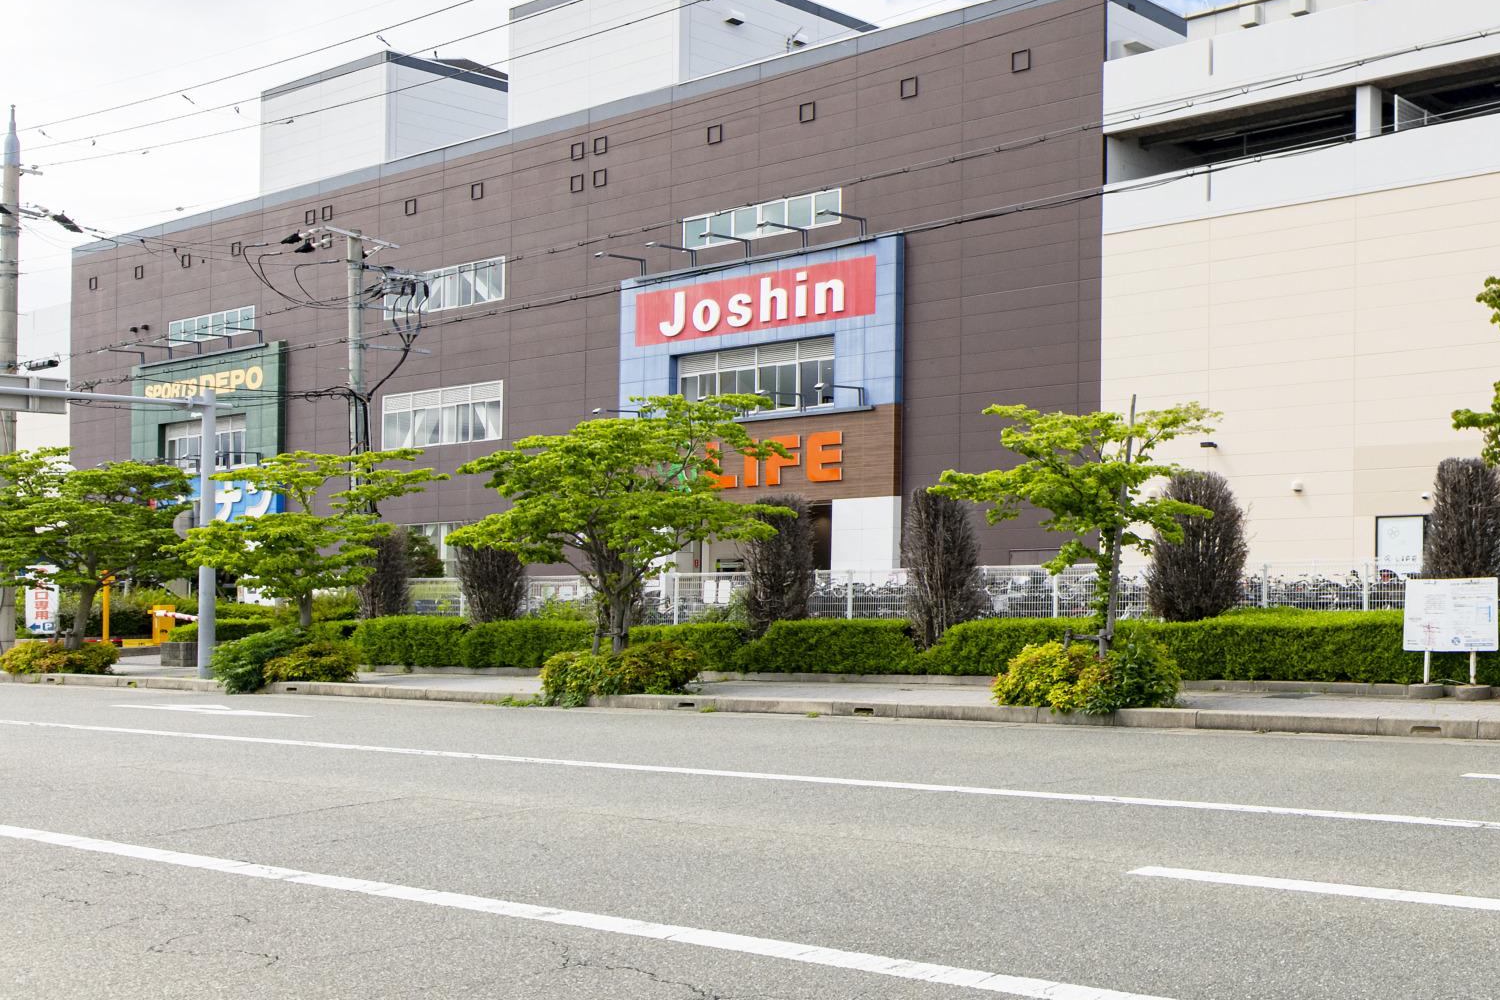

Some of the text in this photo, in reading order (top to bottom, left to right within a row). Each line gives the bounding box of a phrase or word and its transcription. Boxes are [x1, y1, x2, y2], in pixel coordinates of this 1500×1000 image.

[659, 271, 845, 338] Joshin
[144, 366, 264, 400] SPORTS DEPO
[705, 431, 843, 489] LIFE
